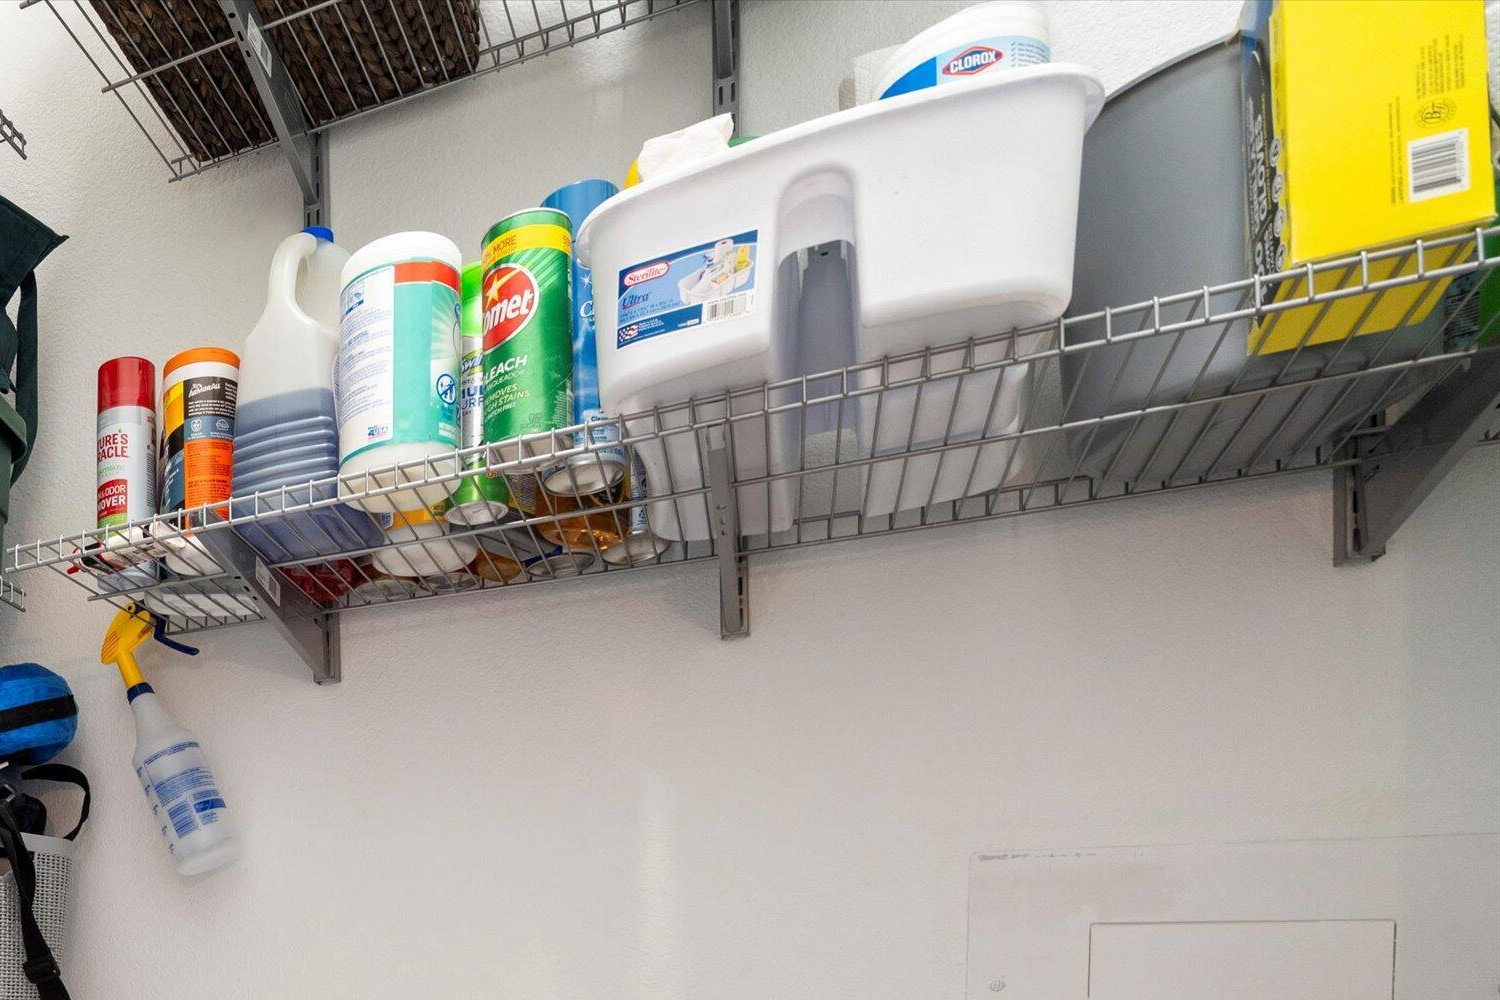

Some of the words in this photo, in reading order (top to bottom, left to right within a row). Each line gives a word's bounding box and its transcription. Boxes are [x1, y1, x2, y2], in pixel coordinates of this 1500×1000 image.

[949, 50, 997, 74] CLOROX
[1250, 114, 1268, 221] GLOVES
[492, 235, 517, 255] MORE
[627, 263, 667, 285] Sterilite
[622, 291, 651, 309] Ultra
[483, 289, 534, 334] omet
[484, 354, 528, 381] LEACH
[105, 485, 126, 496] ODOR
[99, 495, 126, 510] OVER
